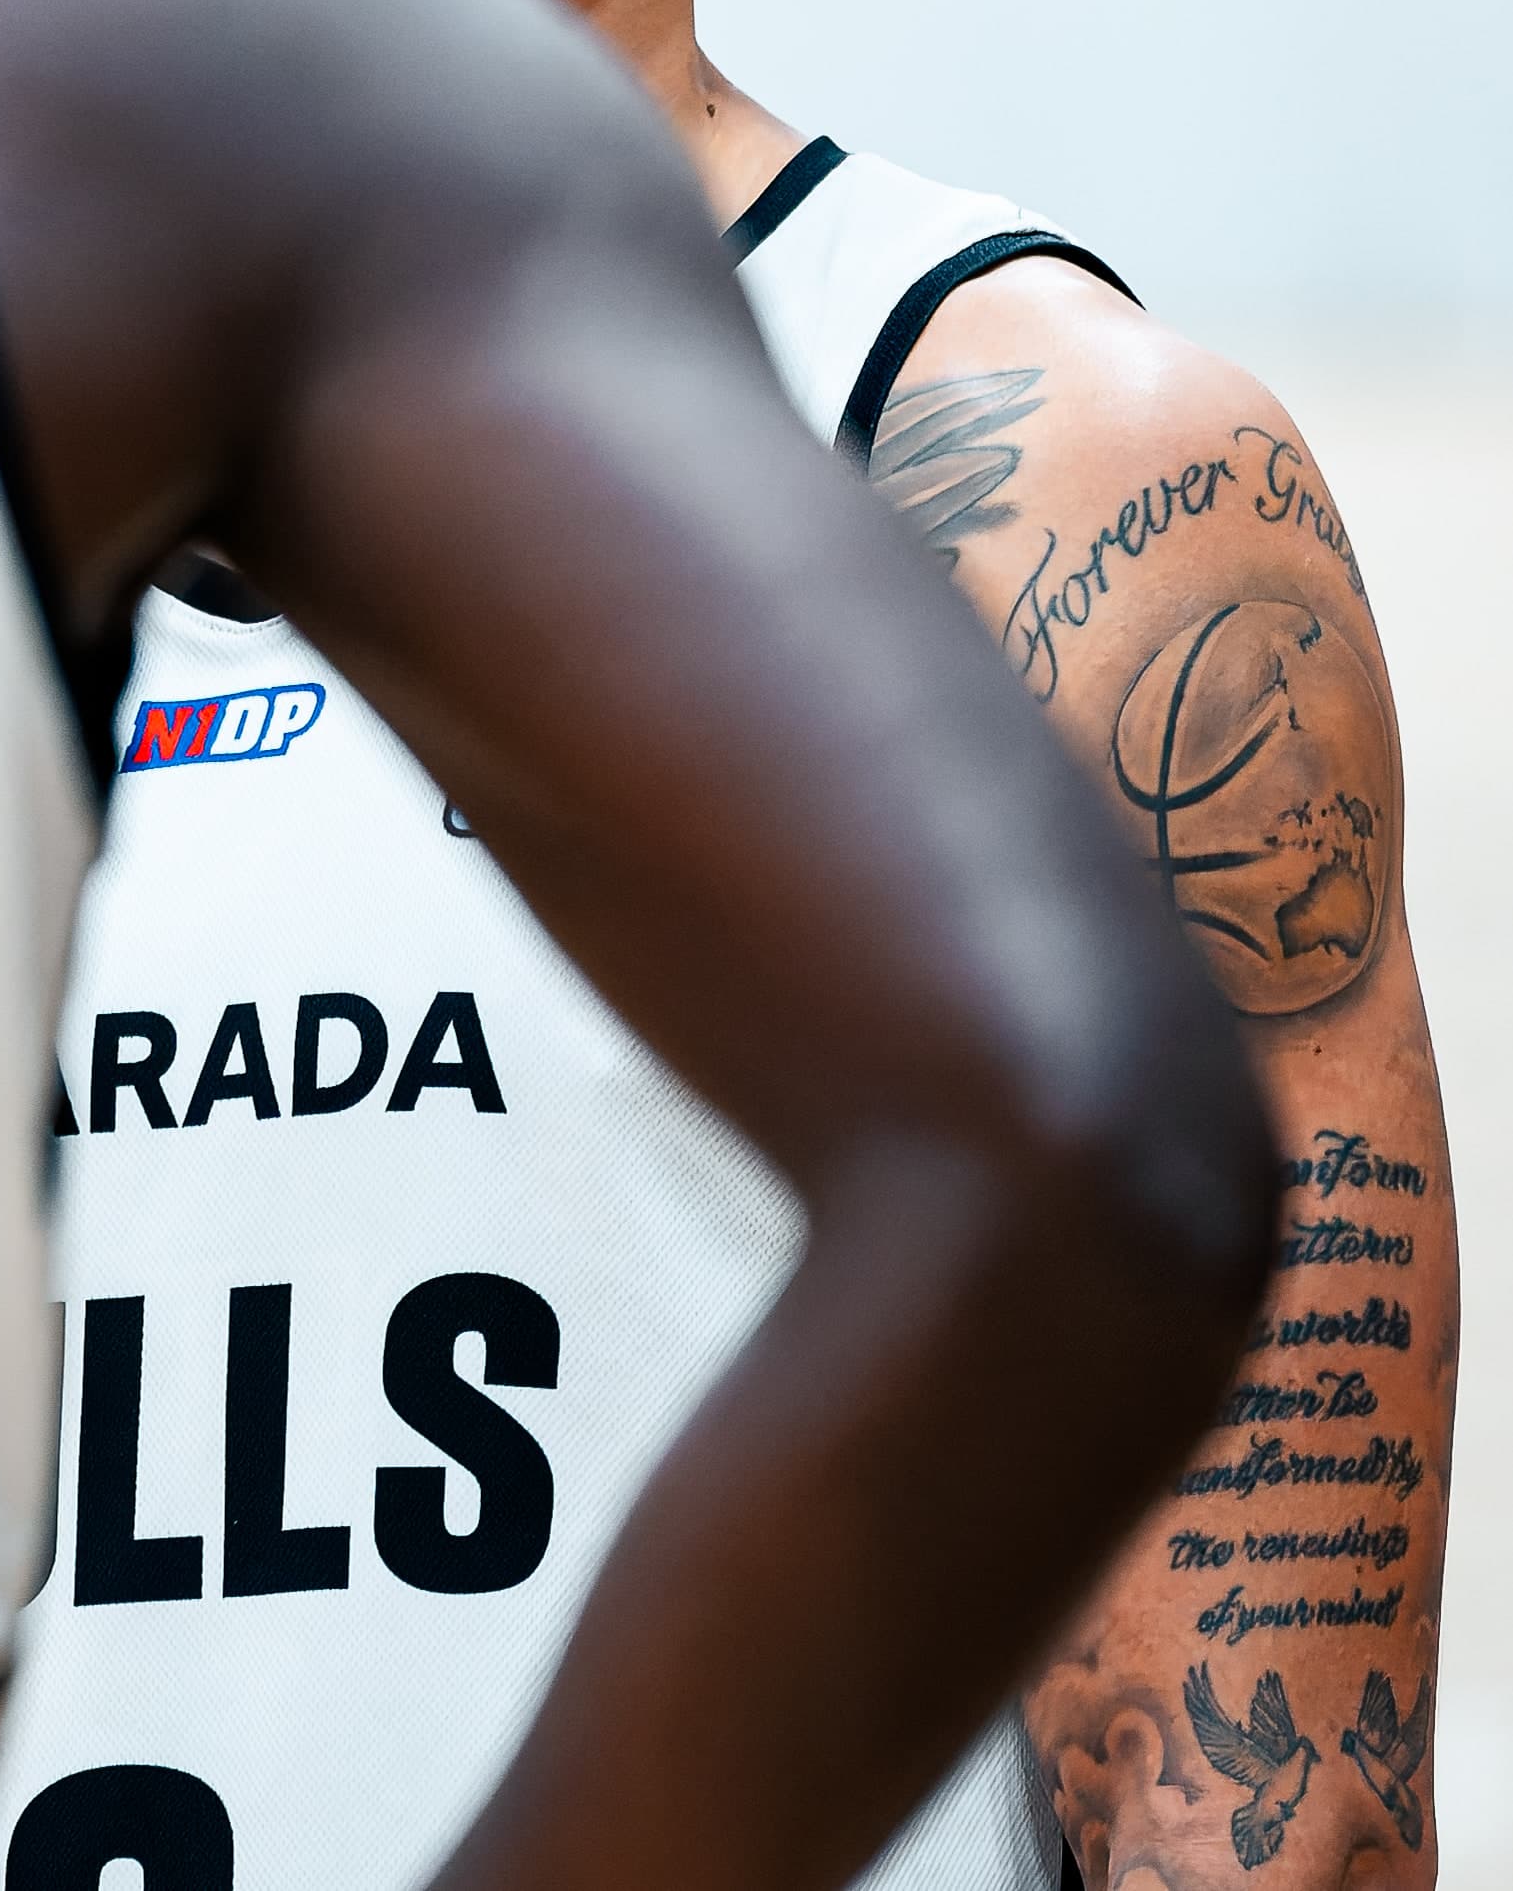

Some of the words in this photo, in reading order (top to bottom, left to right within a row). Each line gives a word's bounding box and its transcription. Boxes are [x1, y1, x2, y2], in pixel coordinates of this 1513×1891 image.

[1000, 462, 1240, 705] Forever
[53, 990, 508, 1137] RADA
[1279, 1216, 1414, 1269] attern
[20, 1270, 562, 1610] LLS
[1176, 1430, 1390, 1501] ansformed
[1241, 1514, 1411, 1573] renewing
[1195, 1582, 1245, 1642] of
[1226, 1595, 1315, 1647] your
[1314, 1581, 1407, 1630] mind
